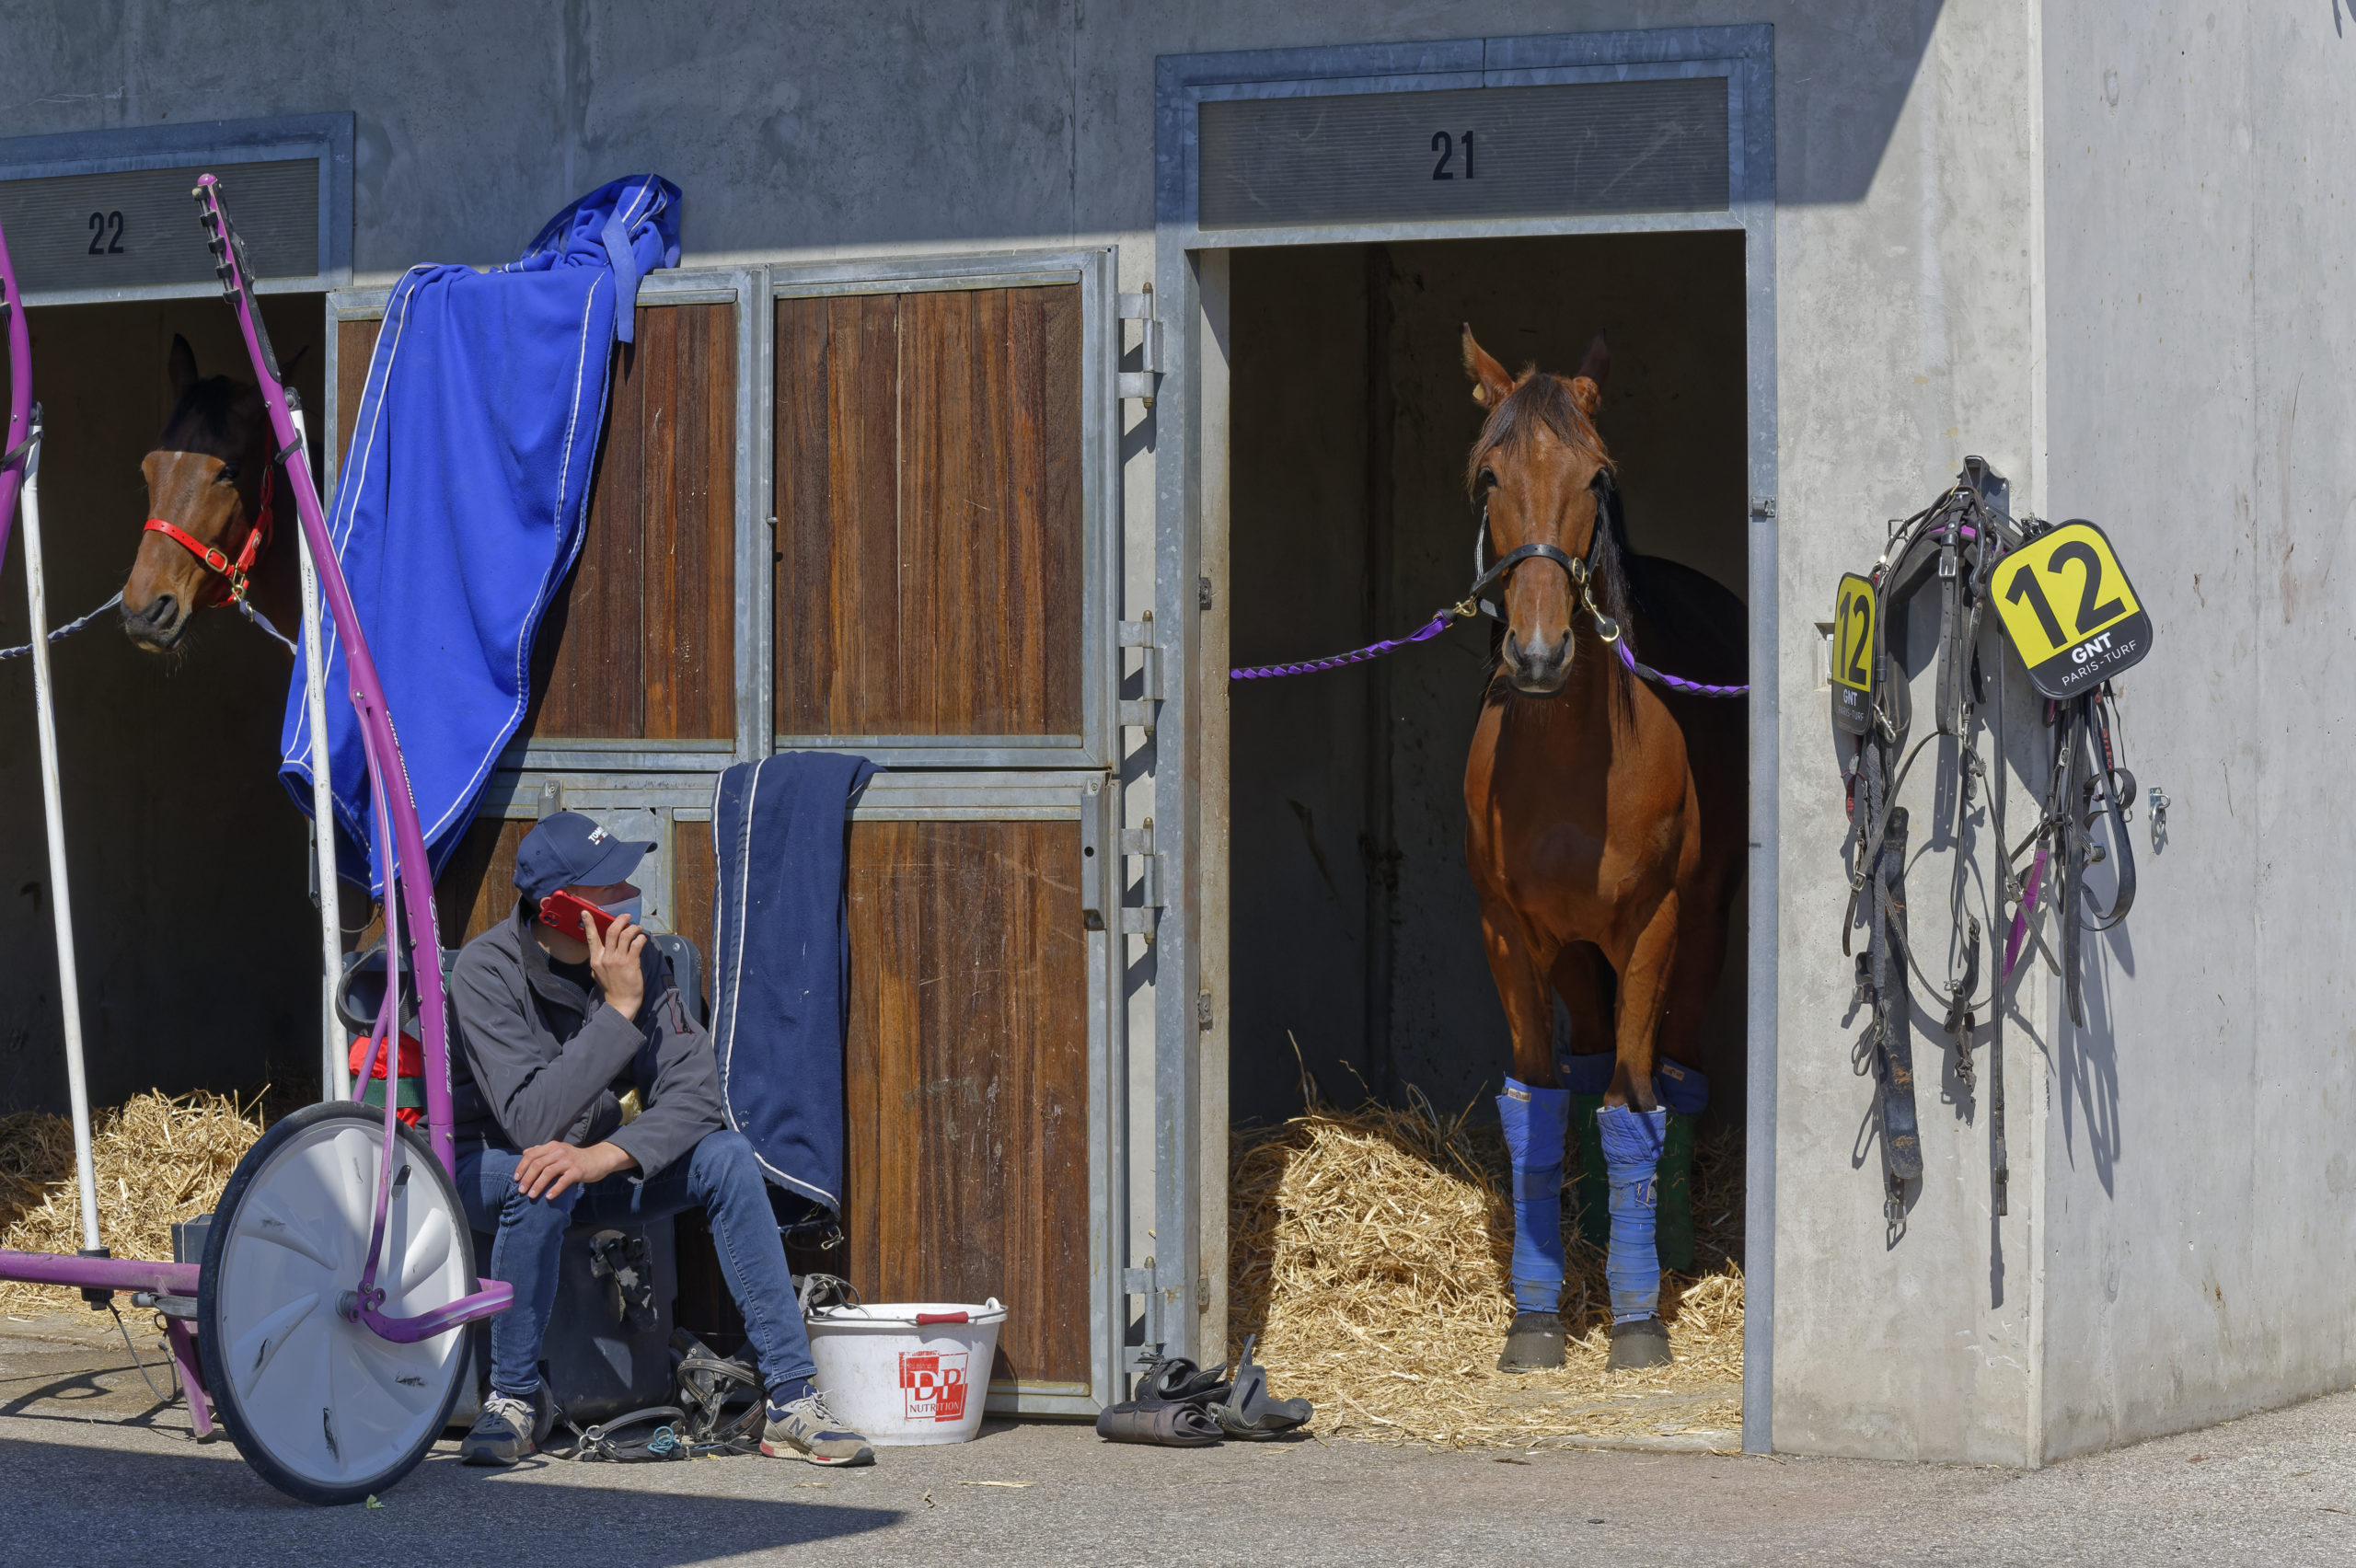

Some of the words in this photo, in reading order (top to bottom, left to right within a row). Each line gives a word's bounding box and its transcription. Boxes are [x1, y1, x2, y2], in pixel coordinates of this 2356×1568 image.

[1431, 130, 1474, 181] 21
[87, 210, 124, 255] 22
[2004, 540, 2128, 650] 12
[1839, 591, 1871, 686] 12
[2071, 631, 2112, 664] GNT
[2061, 640, 2138, 686] PARIS-TURF
[1842, 687, 1858, 708] GNT
[788, 1415, 809, 1439] N
[909, 1401, 960, 1413] NUTRITION
